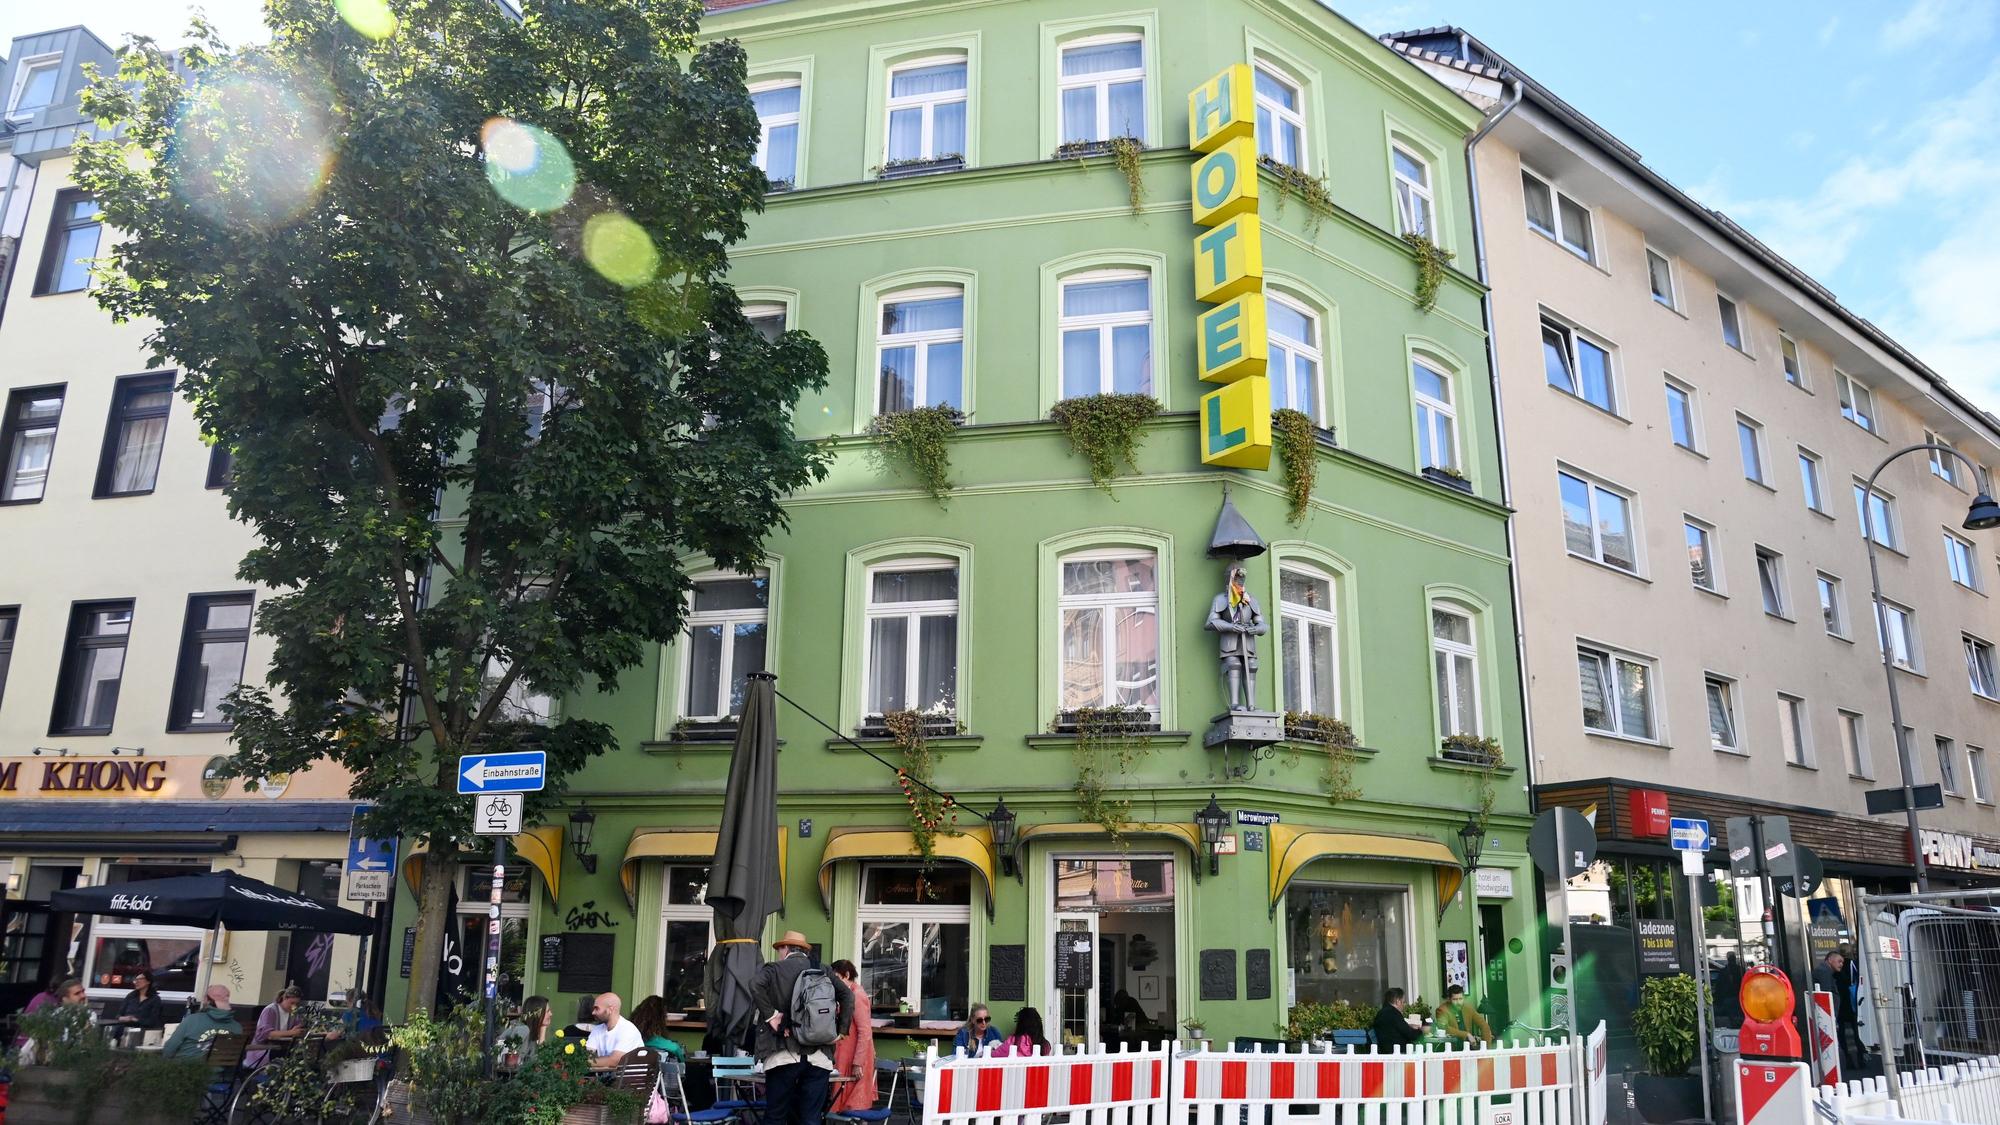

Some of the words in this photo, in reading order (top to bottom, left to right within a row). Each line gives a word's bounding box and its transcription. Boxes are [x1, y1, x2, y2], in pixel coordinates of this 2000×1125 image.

[1195, 72, 1246, 456] HOTEL
[39, 761, 166, 791] KHONG
[483, 767, 540, 778] Einbahnstraße
[355, 882, 382, 890] Parkschein
[110, 893, 155, 911] fritz-kola
[1638, 921, 1675, 935] Ladezone
[1811, 925, 1837, 937] Ladezone
[1642, 938, 1647, 948] 7
[1647, 938, 1656, 948] bis
[1664, 938, 1674, 948] Uhr
[1495, 1115, 1511, 1124] LOKA
